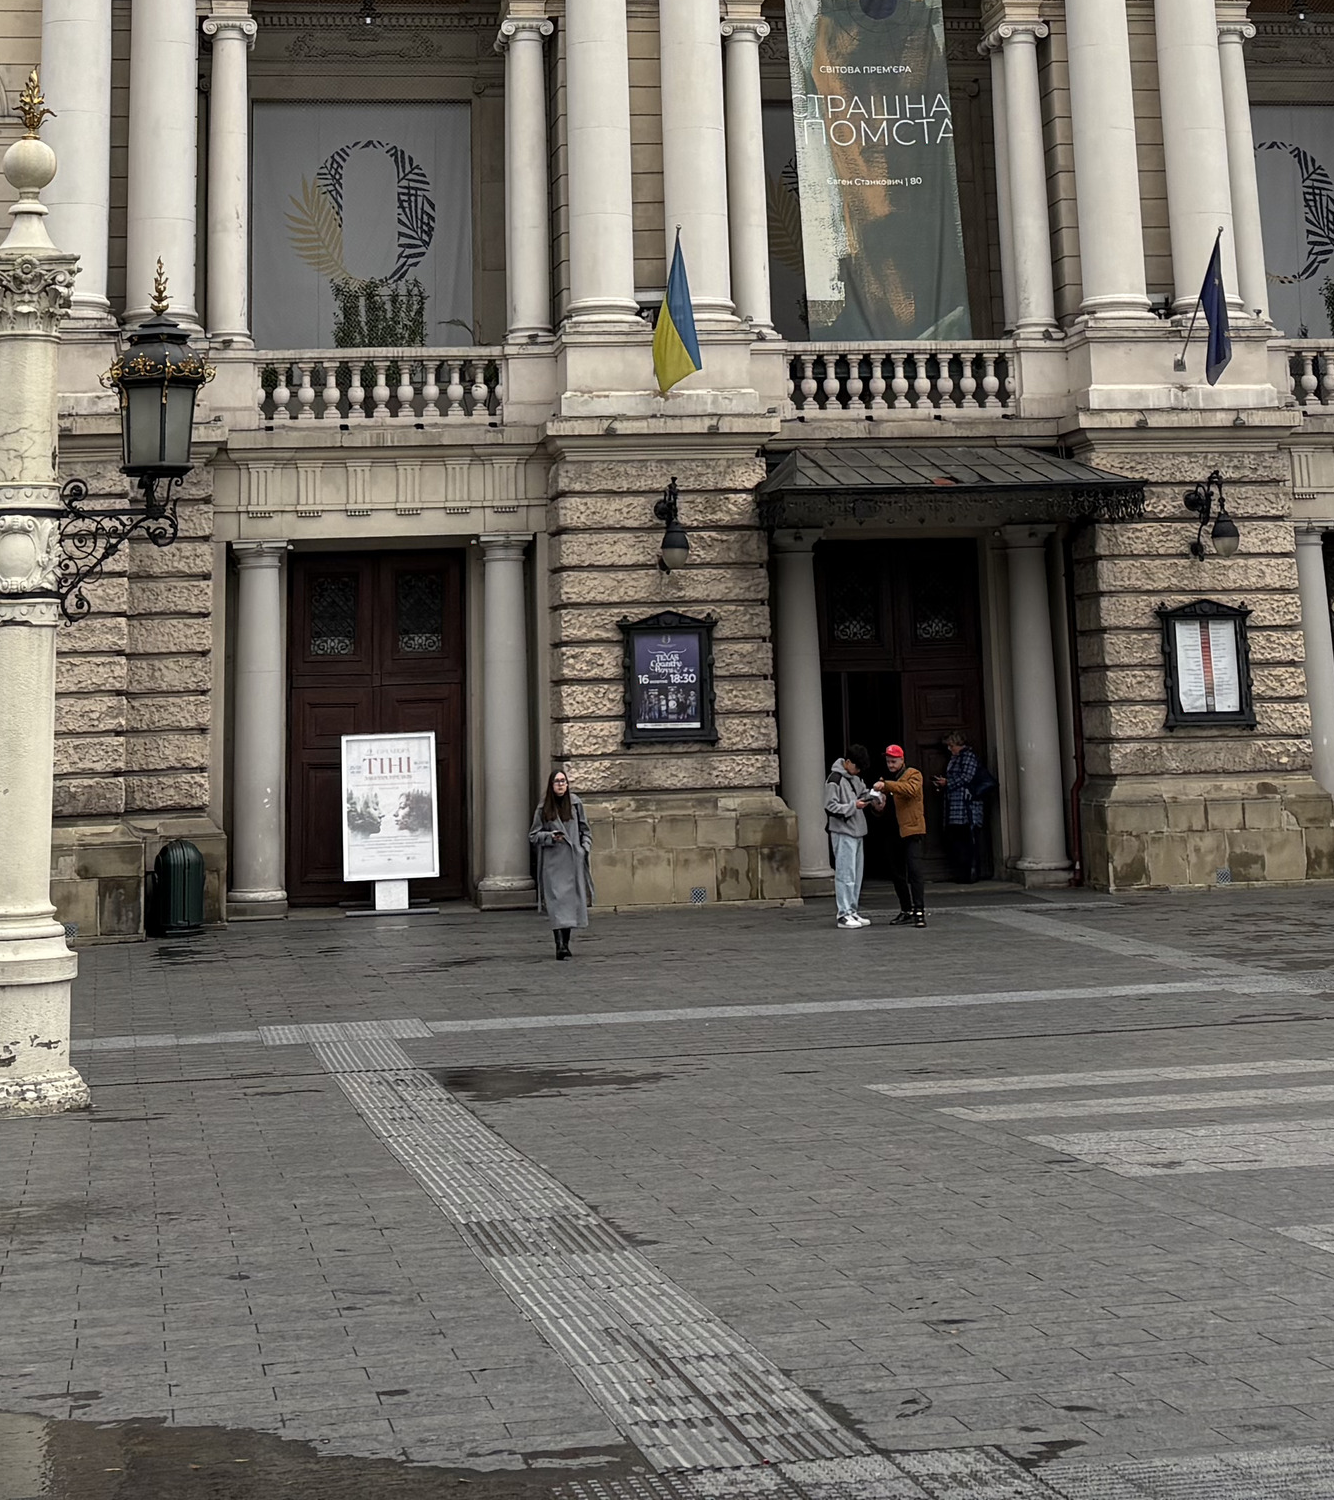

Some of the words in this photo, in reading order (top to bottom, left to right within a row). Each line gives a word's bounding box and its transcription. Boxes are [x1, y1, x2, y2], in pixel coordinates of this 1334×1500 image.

[819, 65, 861, 74] СВІТОВА
[862, 65, 912, 74] ПРЕМ'ЄРА
[792, 93, 952, 119] СТРАШНА
[803, 118, 954, 147] ПОМСТА
[826, 177, 853, 186] Євген
[854, 178, 904, 186] Станкович
[910, 176, 923, 185] 80
[638, 674, 650, 684] 16
[669, 673, 697, 684] 18:30
[362, 756, 411, 775] ТІНІ
